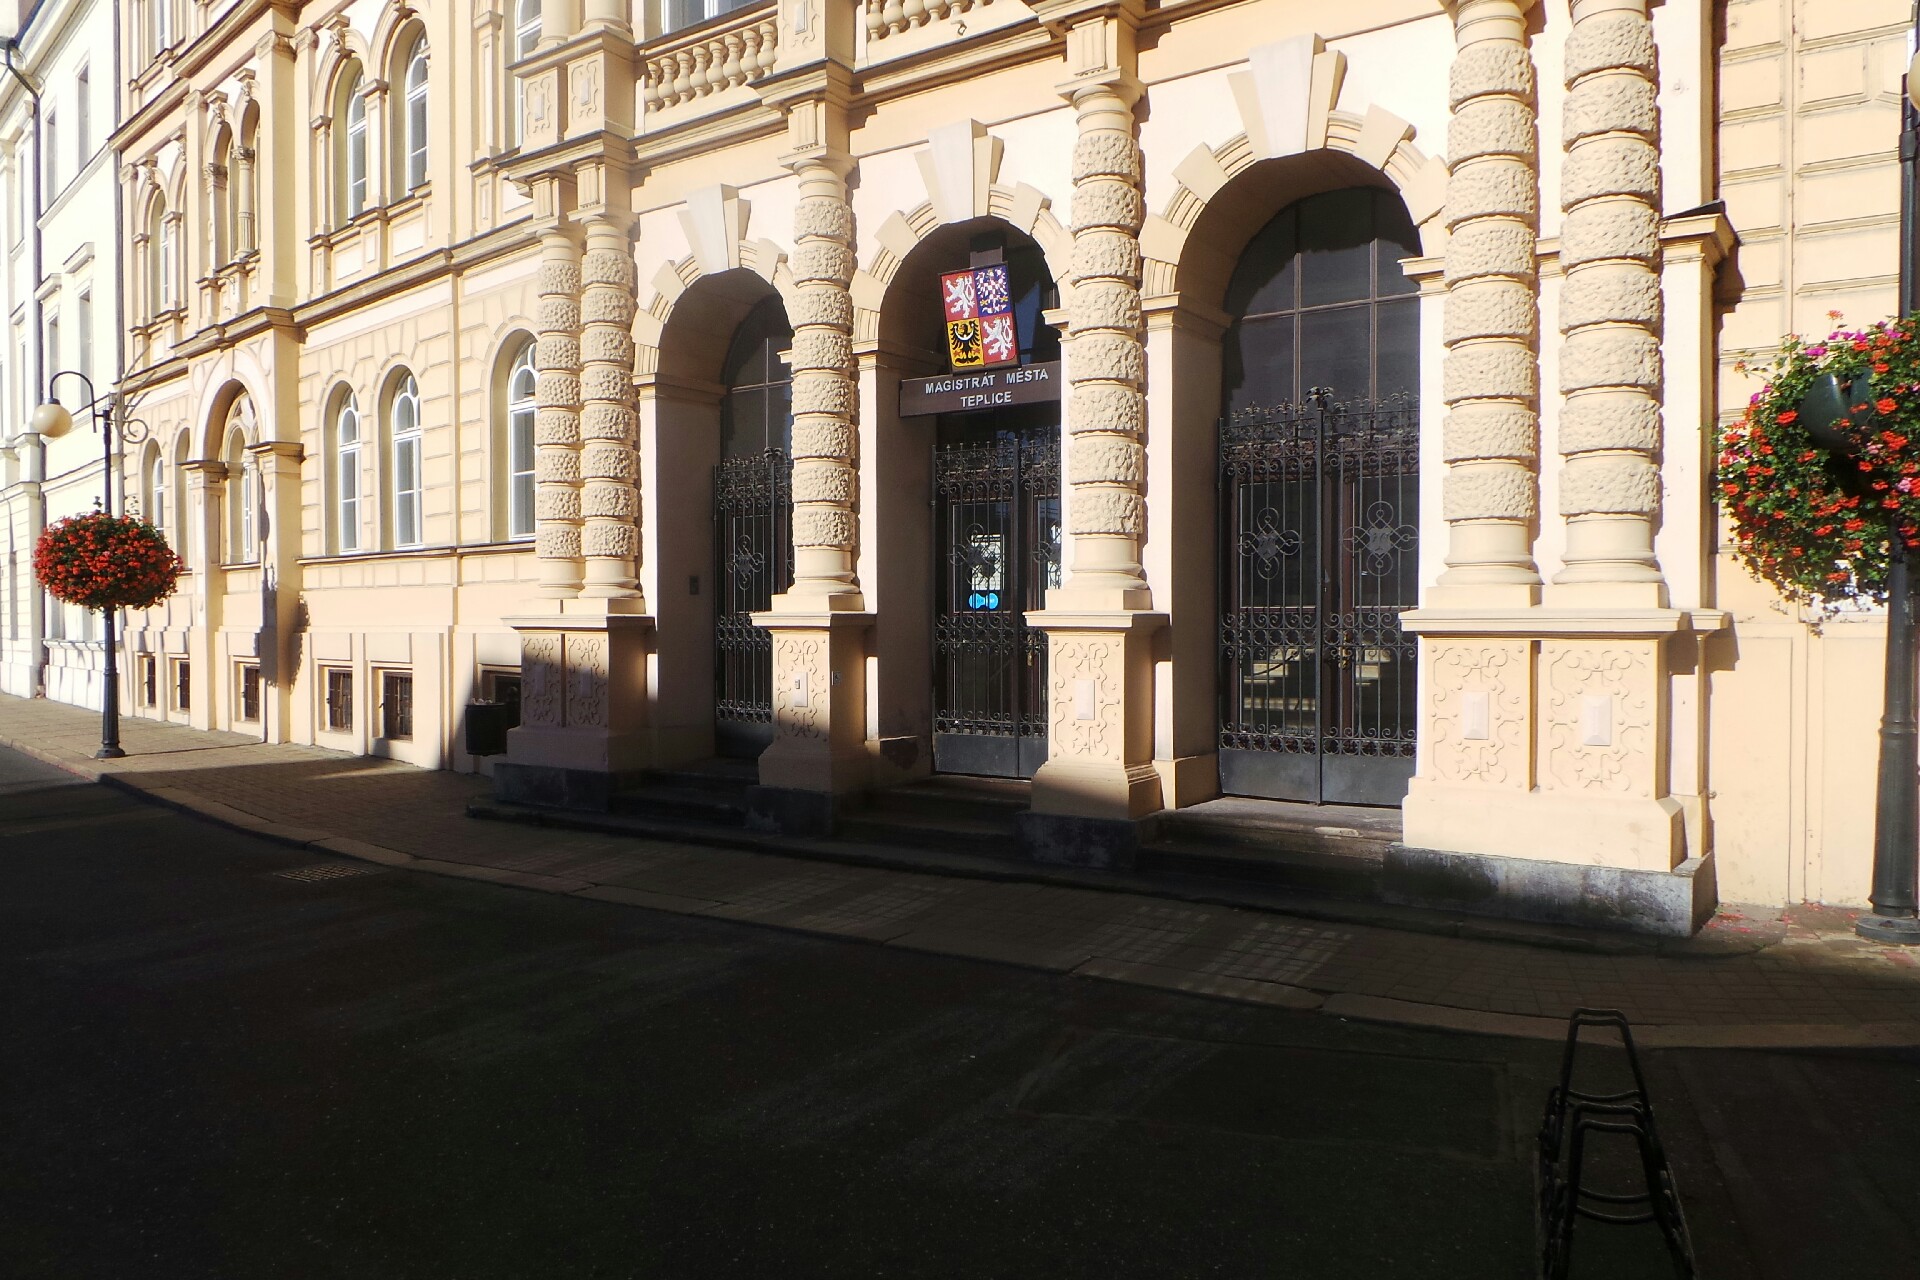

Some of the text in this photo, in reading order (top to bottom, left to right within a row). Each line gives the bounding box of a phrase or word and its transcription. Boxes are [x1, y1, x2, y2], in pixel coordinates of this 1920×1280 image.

[925, 368, 1049, 394] MAGISTRÁT MĚSTA
[960, 391, 1012, 408] TEPLICE
